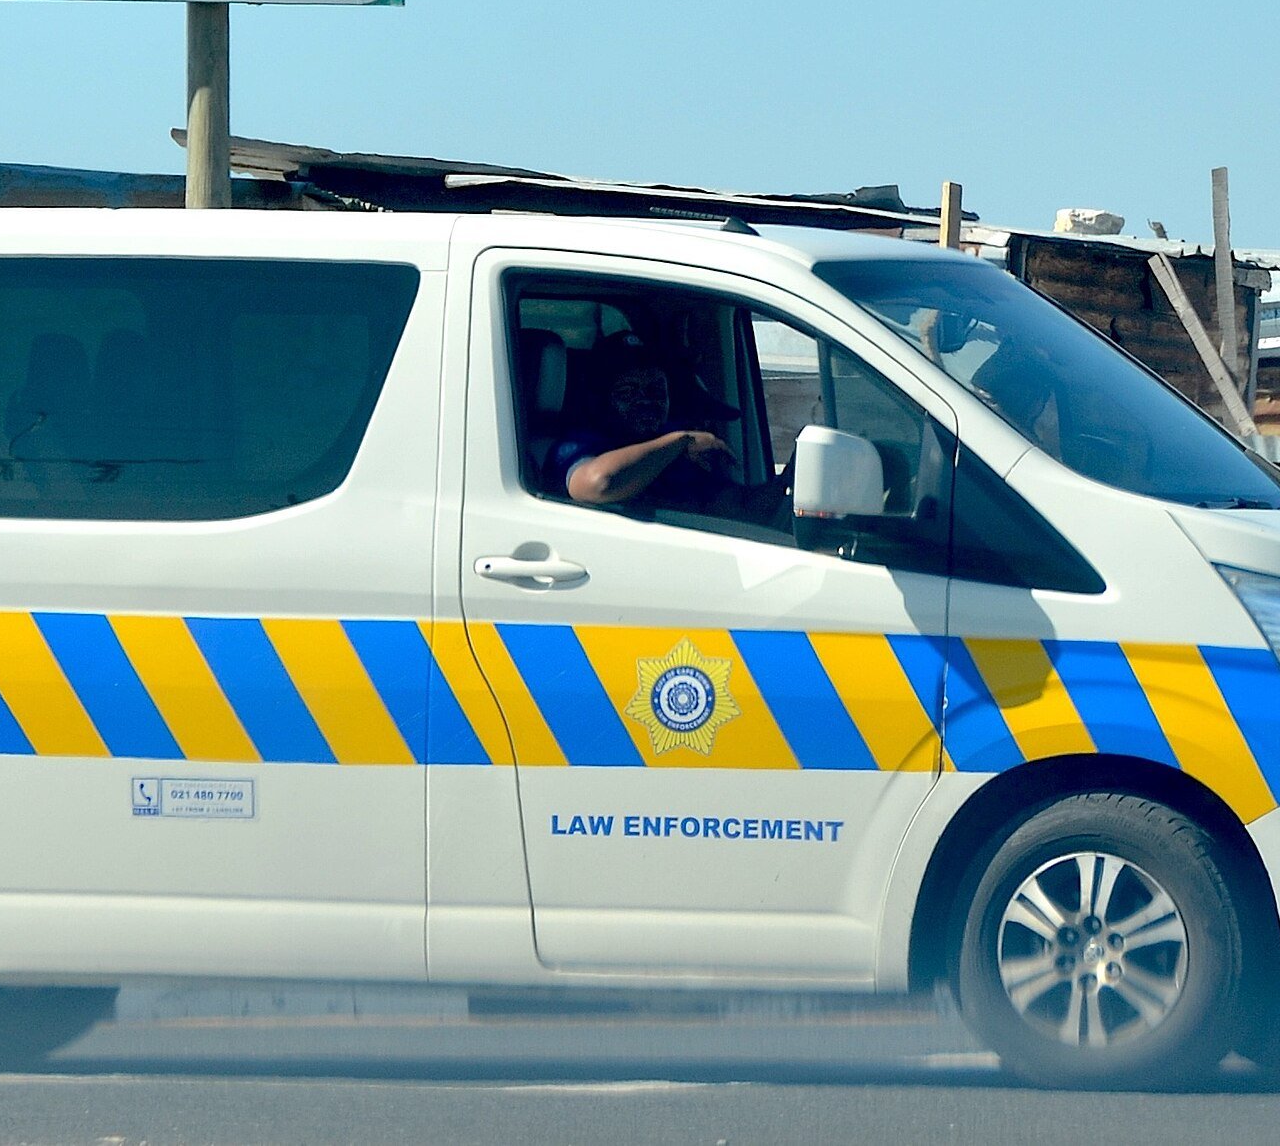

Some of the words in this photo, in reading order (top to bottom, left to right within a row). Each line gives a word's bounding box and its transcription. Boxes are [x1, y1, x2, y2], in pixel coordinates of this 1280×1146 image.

[170, 789, 190, 800] 021
[551, 815, 614, 836] LAW
[624, 816, 844, 842] ENFORCEMENT
